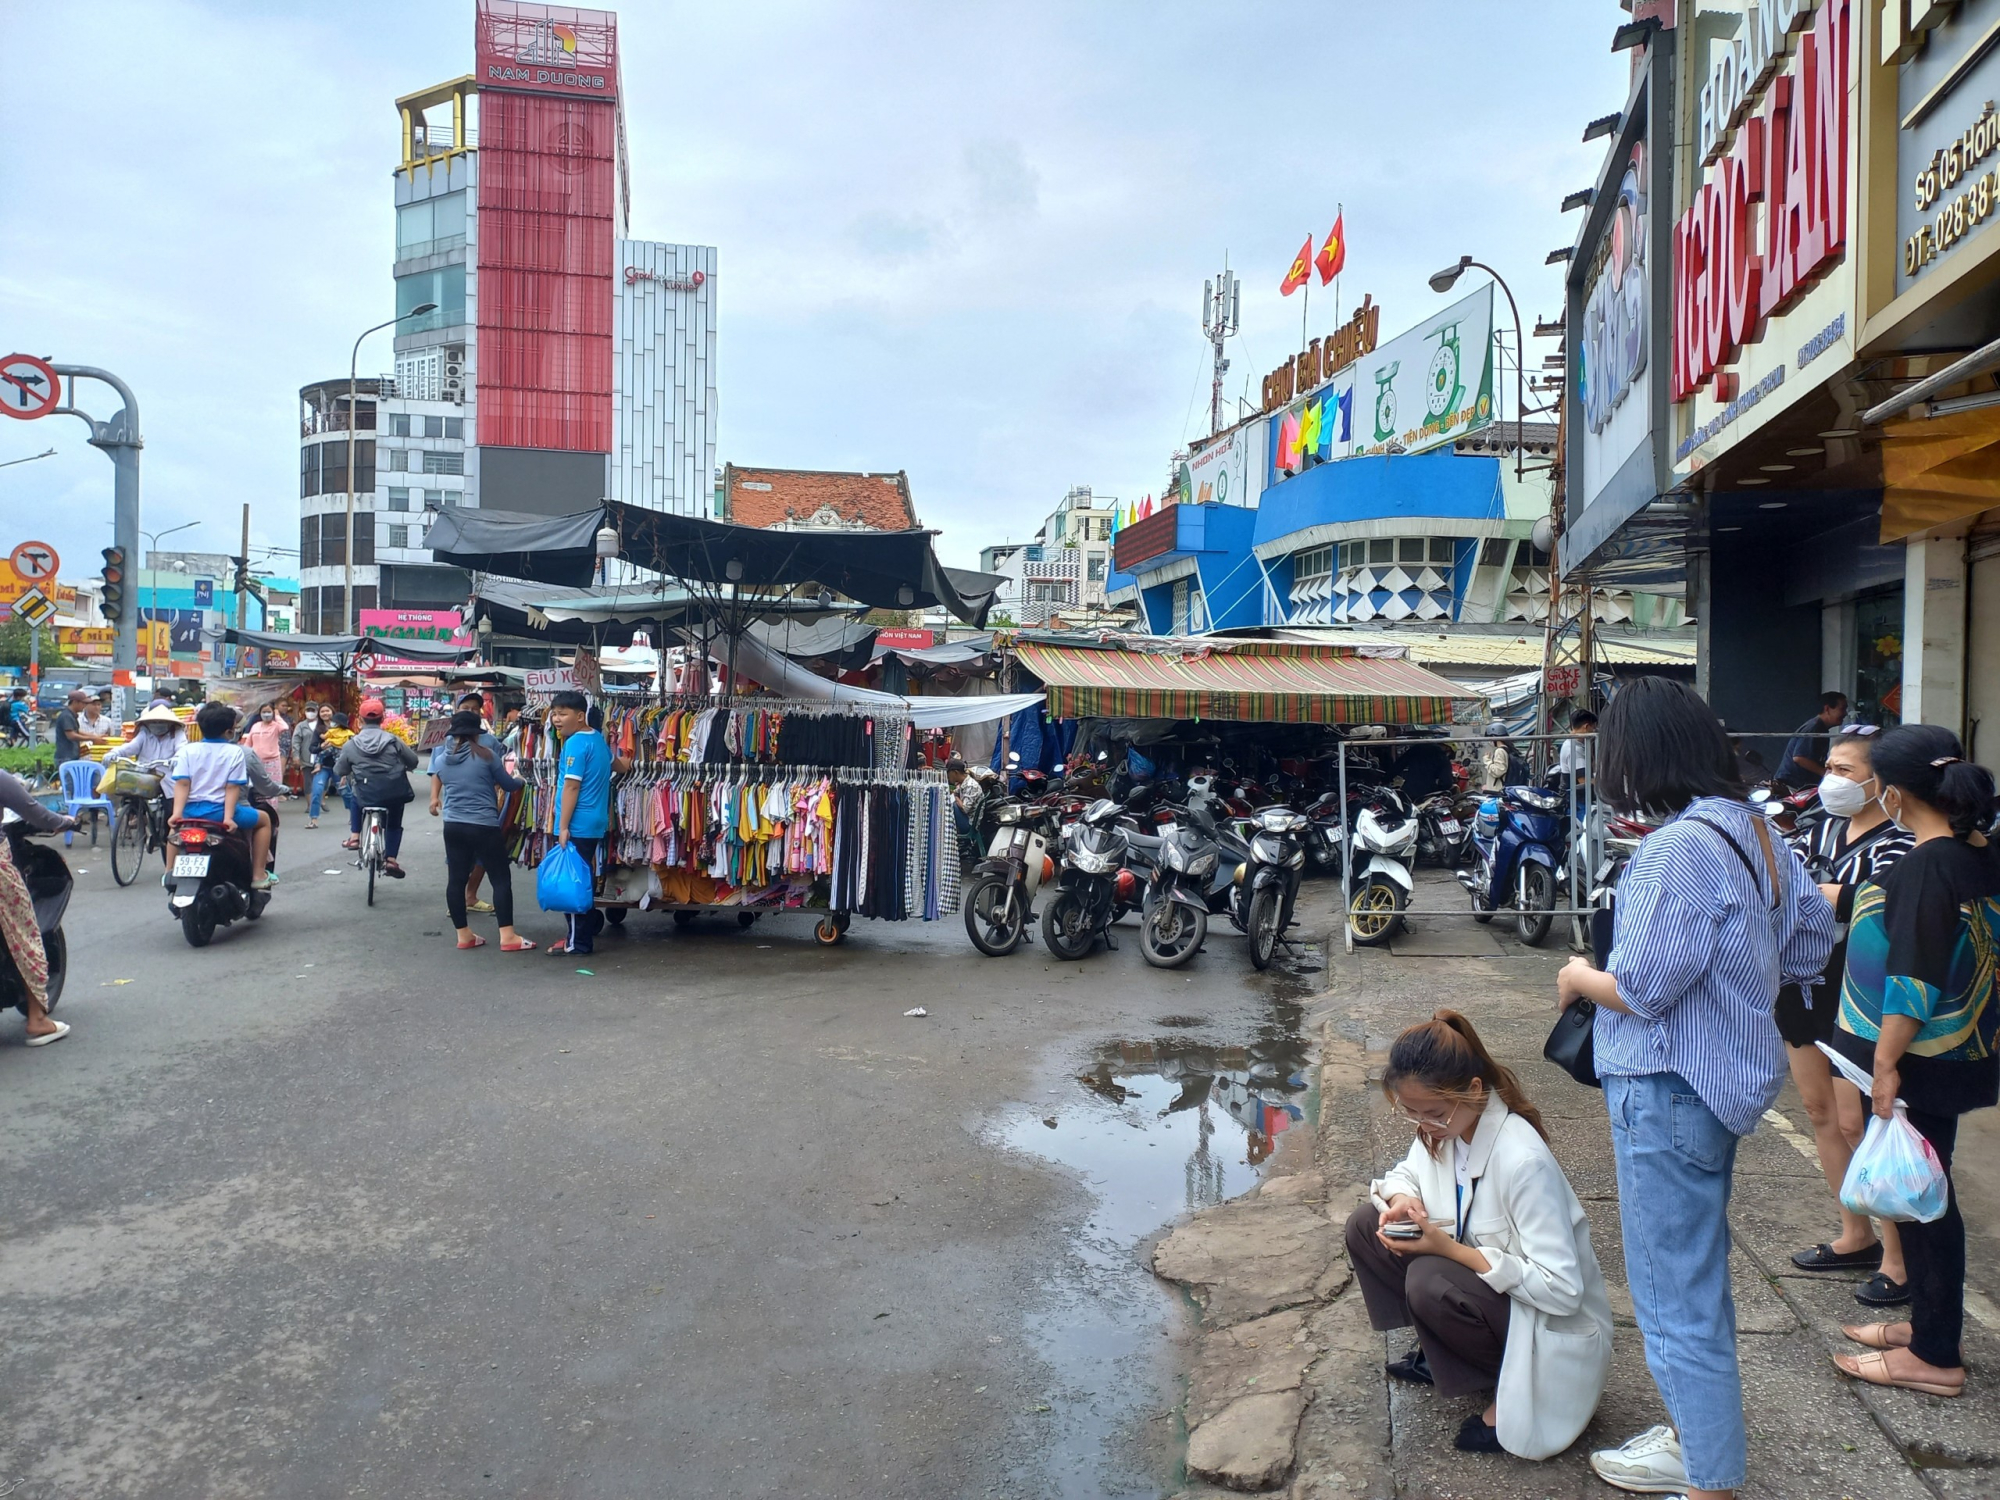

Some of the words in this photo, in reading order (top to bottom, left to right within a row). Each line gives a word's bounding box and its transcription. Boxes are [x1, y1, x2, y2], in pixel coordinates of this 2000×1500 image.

[488, 65, 530, 81] NAM
[1940, 139, 1962, 190] 05
[1963, 101, 2000, 172] Hồn
[1672, 116, 1757, 402] NGỌC
[1758, 0, 1850, 318] LAN
[1936, 195, 1965, 251] 028
[1968, 174, 1991, 226] 38
[197, 590, 209, 599] PNJ
[180, 856, 205, 866] 59-F2
